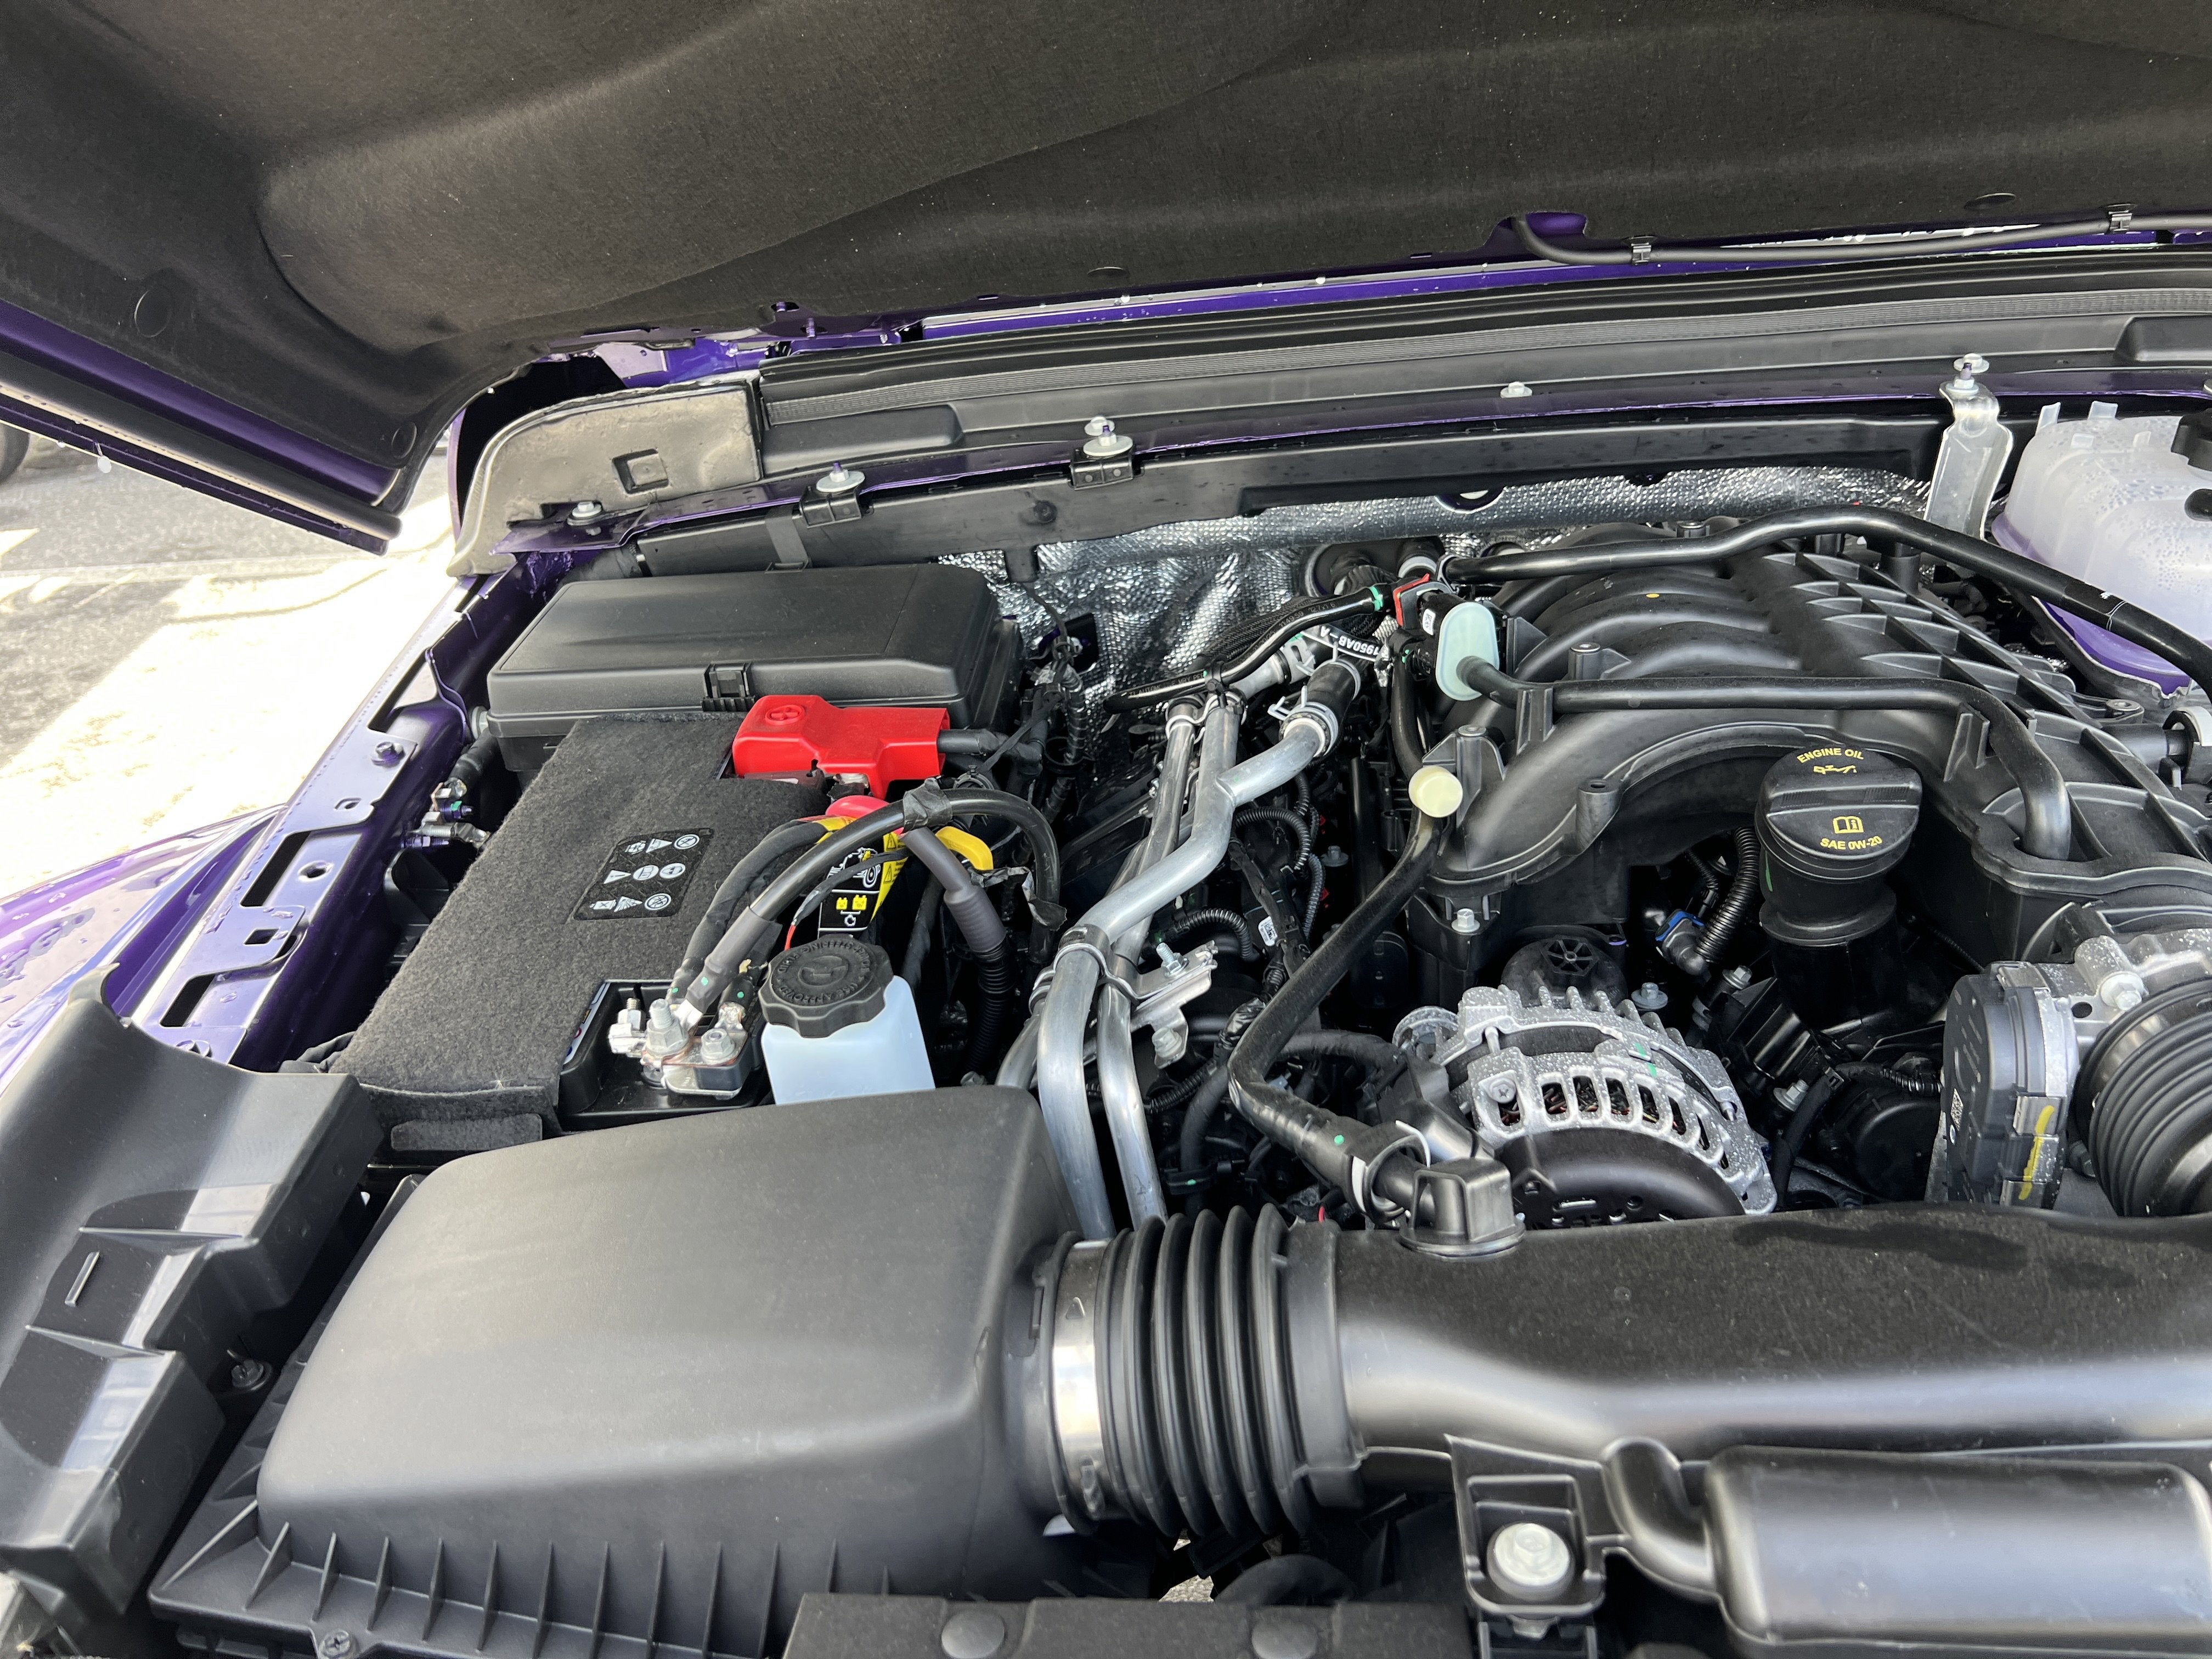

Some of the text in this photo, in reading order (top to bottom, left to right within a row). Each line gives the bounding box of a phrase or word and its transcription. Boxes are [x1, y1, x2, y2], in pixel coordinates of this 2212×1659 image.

[1797, 748, 1864, 764] ENGINE OIL
[1820, 835, 1883, 850] SAE 0W-20
[801, 940, 854, 953] STEERING
